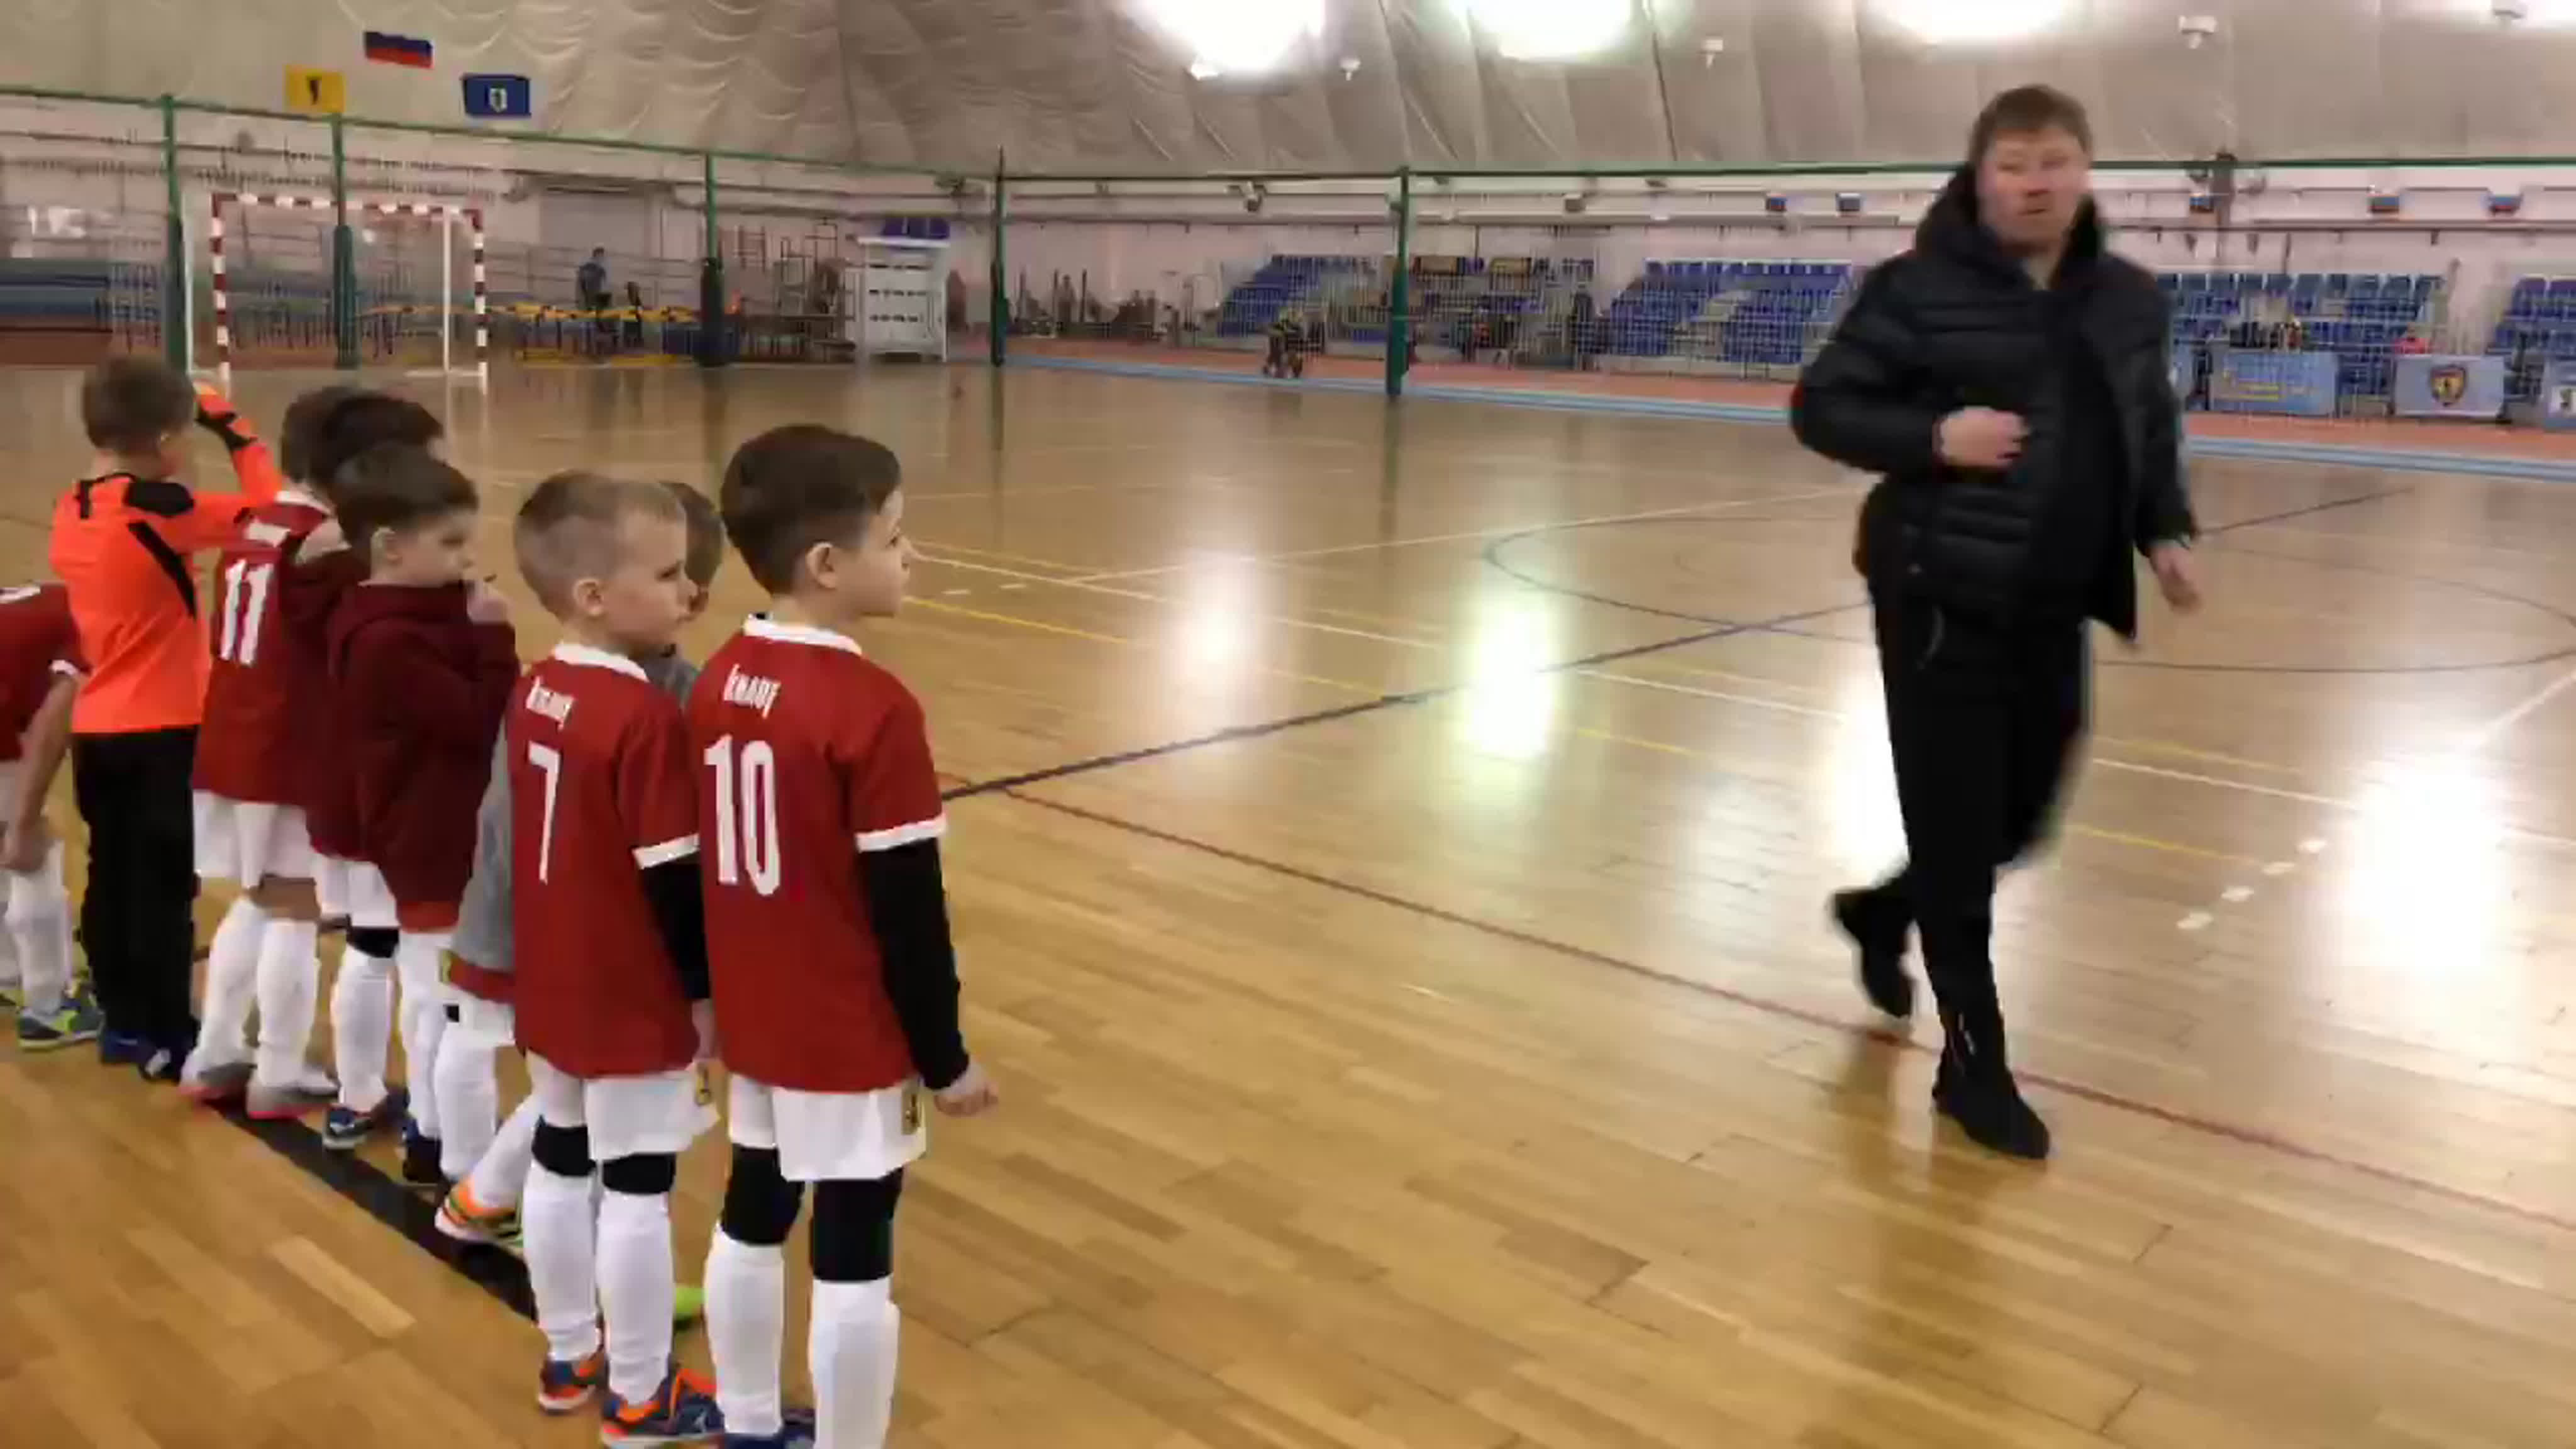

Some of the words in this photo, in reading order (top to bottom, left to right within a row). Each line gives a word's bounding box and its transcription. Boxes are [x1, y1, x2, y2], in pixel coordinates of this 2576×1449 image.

[221, 558, 275, 665] 11
[528, 740, 561, 885] 7
[703, 733, 780, 896] 10
